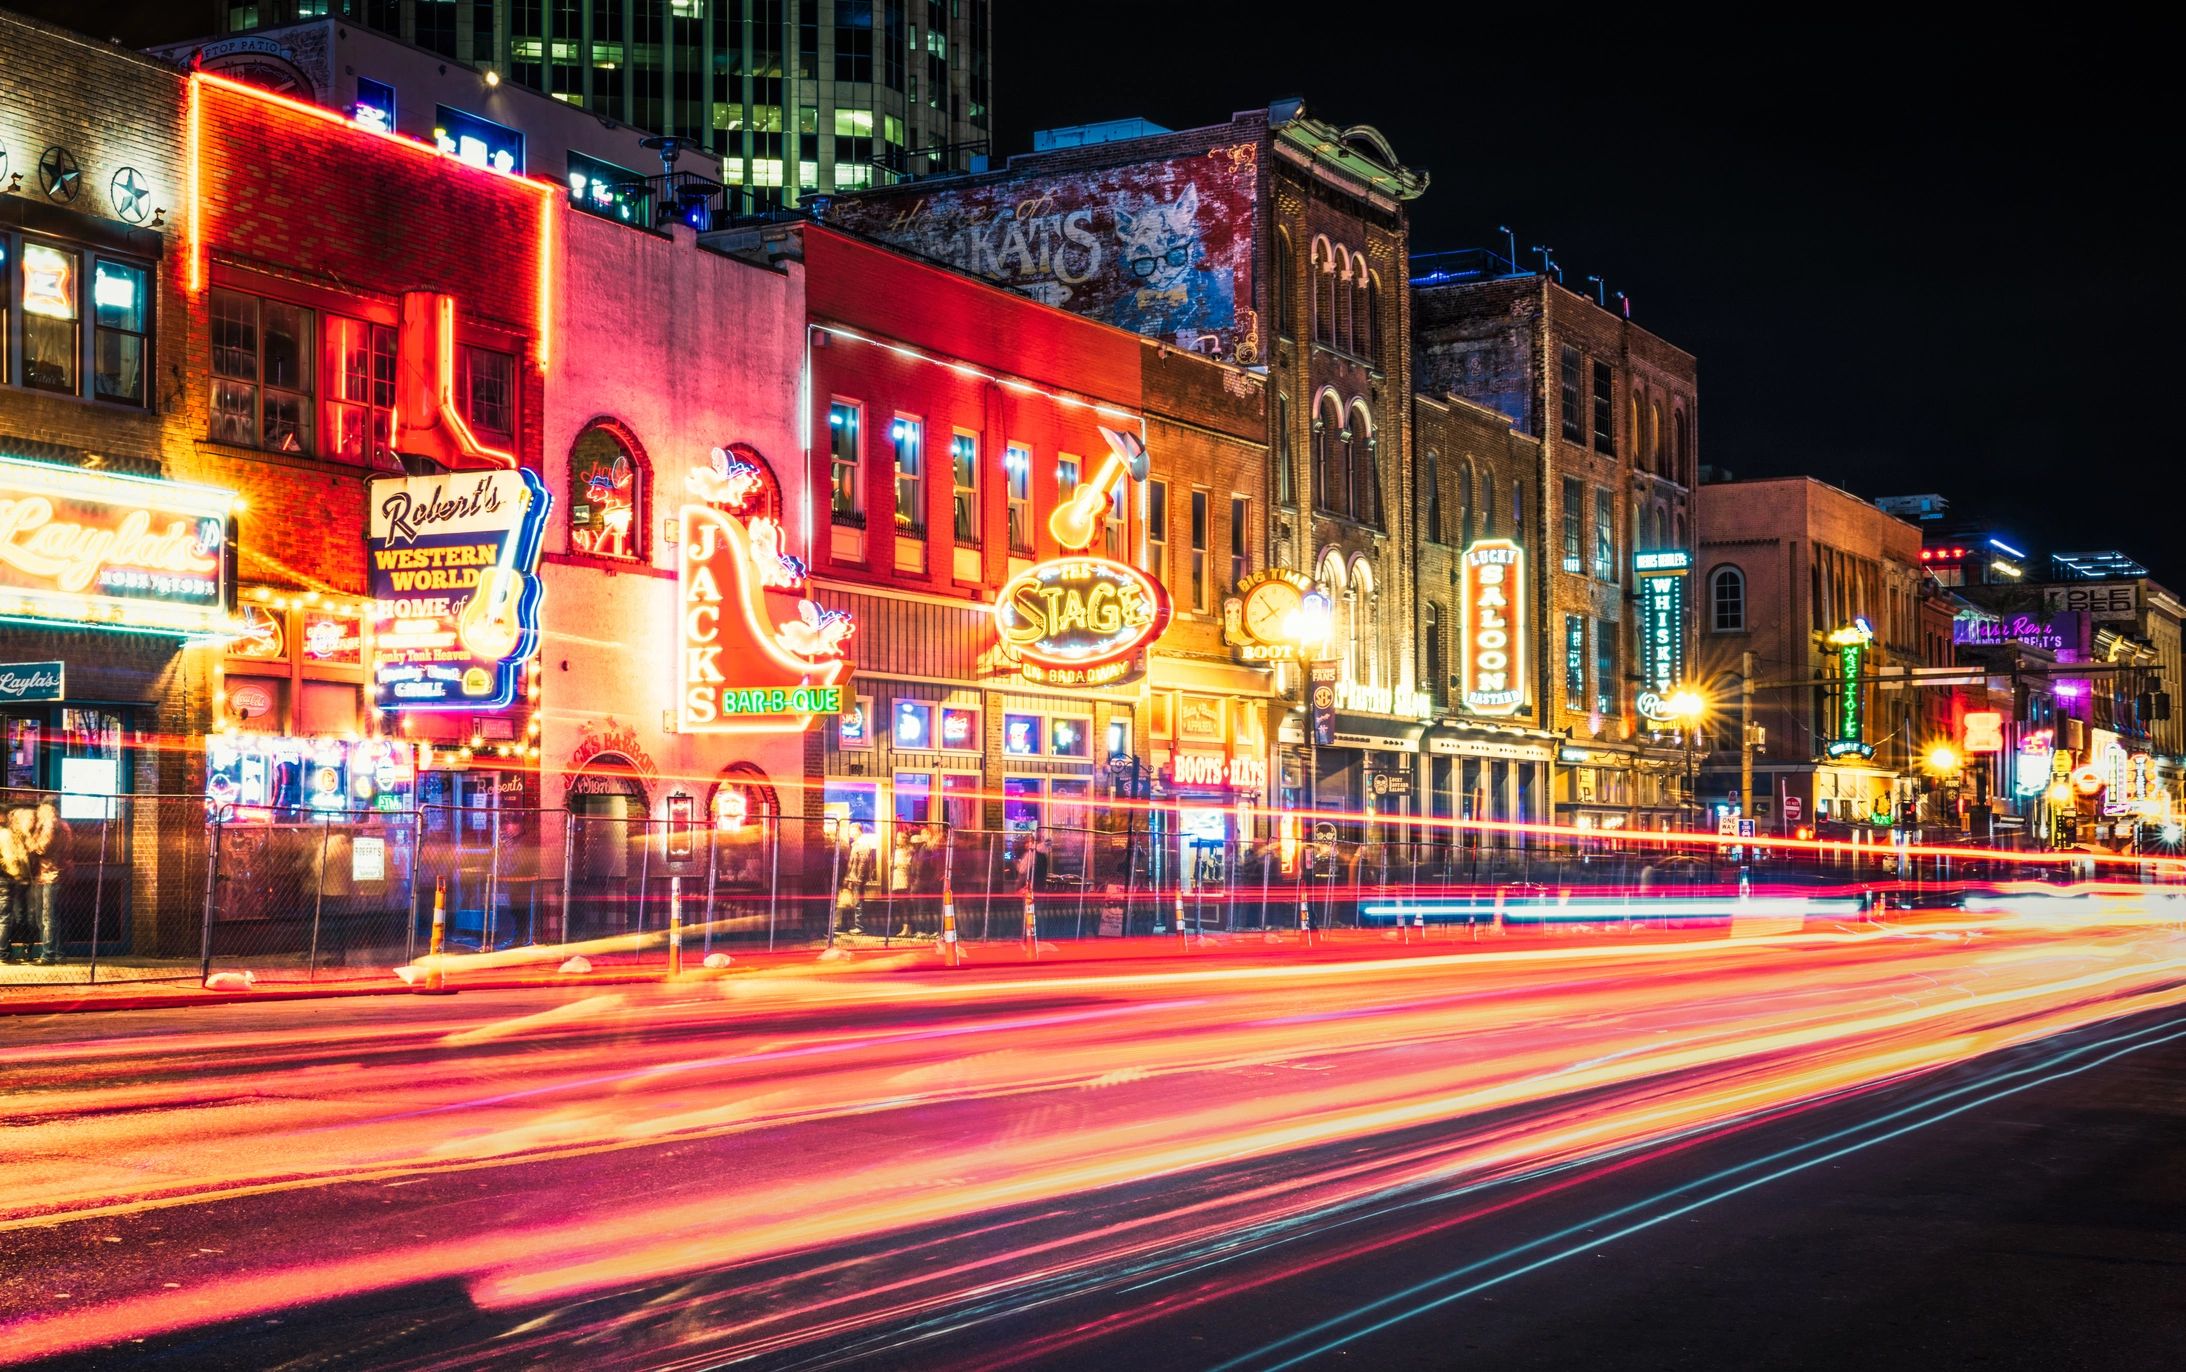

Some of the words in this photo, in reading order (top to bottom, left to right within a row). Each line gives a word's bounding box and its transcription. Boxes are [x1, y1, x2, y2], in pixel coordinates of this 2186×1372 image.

[240, 41, 278, 57] PATIO
[970, 208, 1104, 285] KATS
[382, 475, 502, 548] Robert's
[0, 496, 217, 593] Layla's
[375, 544, 498, 571] WESTERN
[1469, 549, 1518, 566] LUCKY
[390, 569, 480, 592] WORLD
[1237, 571, 1266, 593] BIG
[1269, 568, 1311, 591] TIME
[374, 597, 451, 619] HOME
[451, 594, 469, 614] of
[2068, 588, 2132, 601] OLE
[2068, 601, 2132, 612] RED
[1006, 576, 1151, 644] STAGE
[1477, 564, 1509, 692] SALOON
[1651, 578, 1672, 695] WHISKEY
[433, 649, 472, 662] Heaven
[1241, 645, 1293, 659] BOOT
[0, 671, 59, 697] Layla's
[1022, 662, 1042, 681] ON
[1049, 660, 1130, 684] BROADWAY
[1312, 672, 1336, 682] FANS
[723, 687, 839, 713] BAR-B-QUE
[1469, 690, 1521, 705] BASTARD
[1174, 755, 1222, 785] BOOTS
[1229, 757, 1265, 787] HATS
